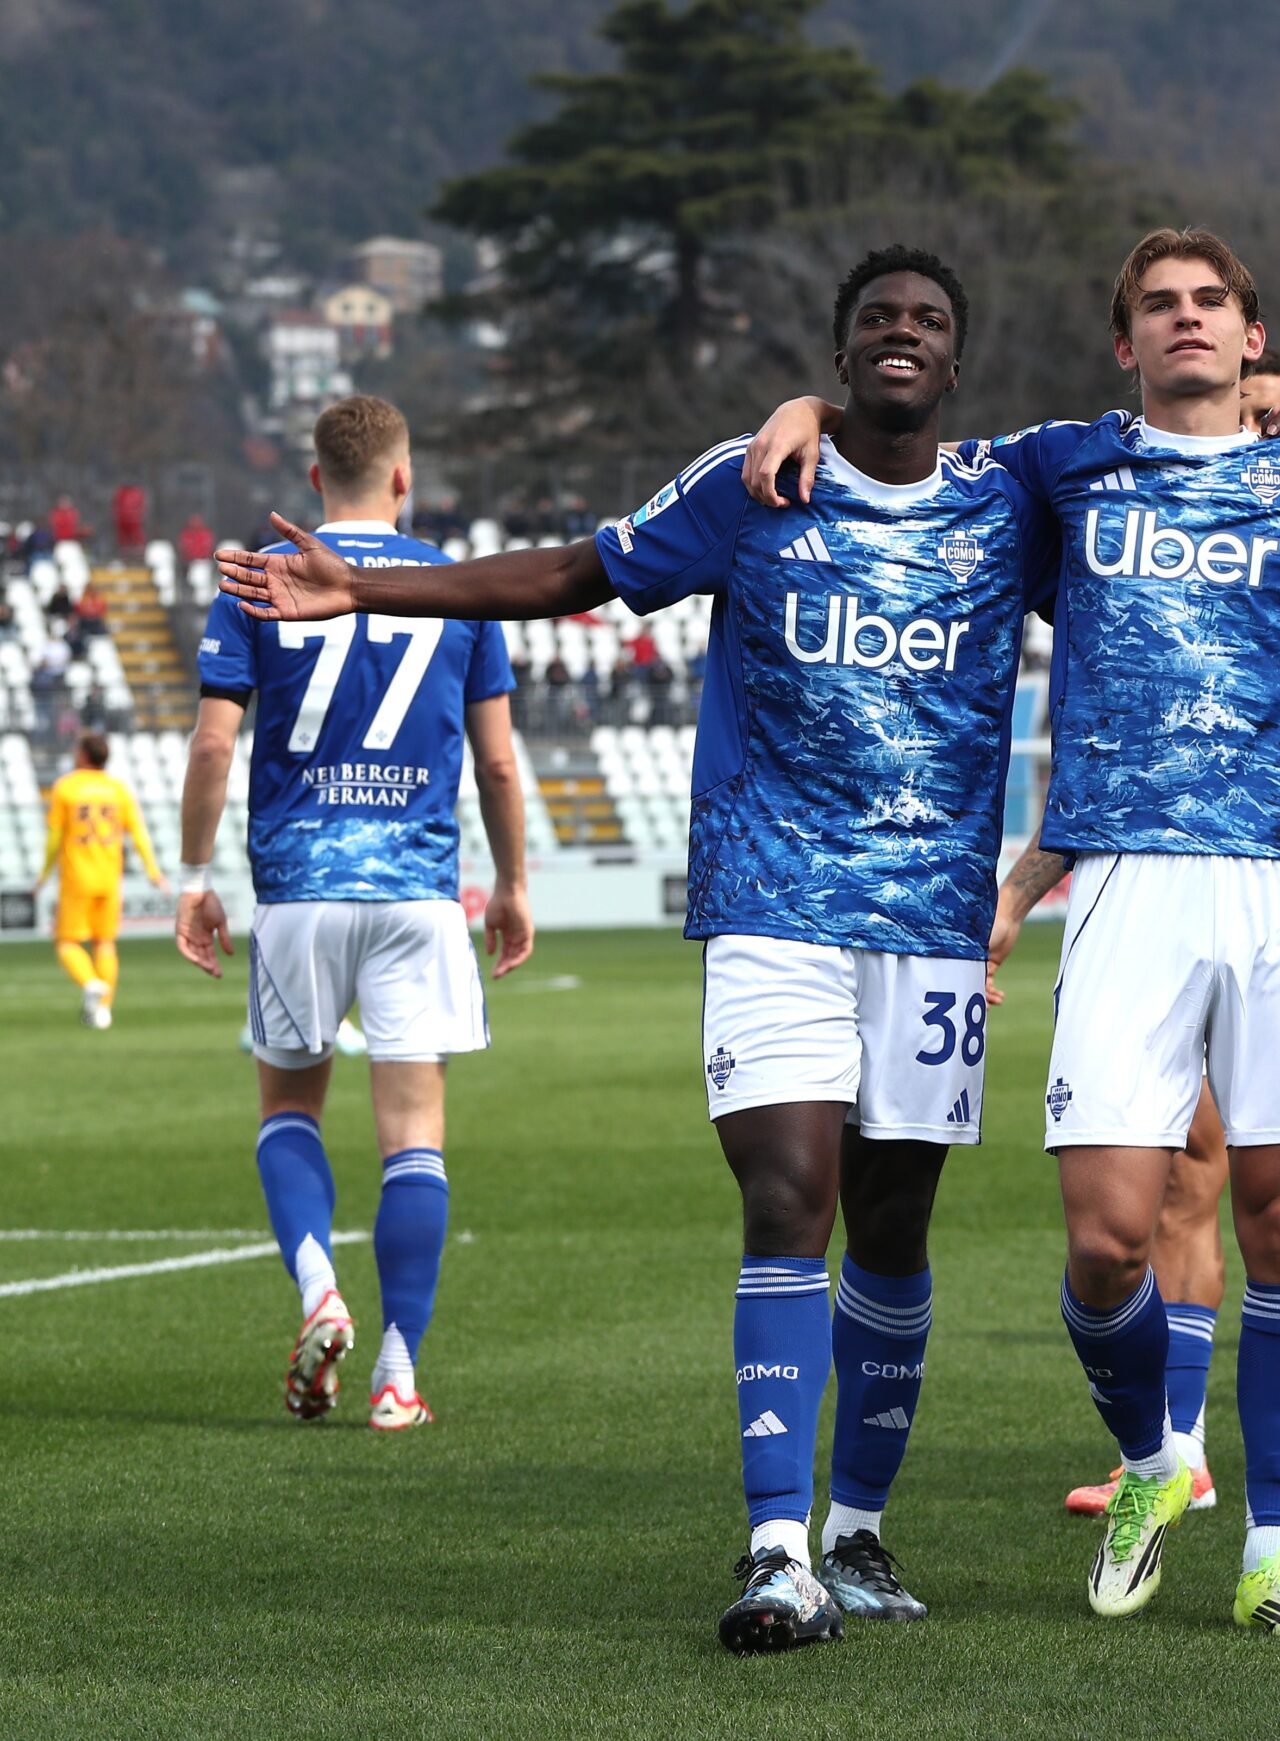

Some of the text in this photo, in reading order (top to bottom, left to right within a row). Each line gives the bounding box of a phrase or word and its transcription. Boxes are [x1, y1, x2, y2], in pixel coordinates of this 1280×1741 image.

[1251, 472, 1280, 486] COMO
[947, 546, 975, 560] COMO
[1085, 509, 1279, 588] Uber
[784, 592, 970, 671] Uber
[277, 612, 445, 753] 77
[915, 991, 987, 1067] 38
[712, 1059, 730, 1073] COMO
[736, 1362, 799, 1385] COMO
